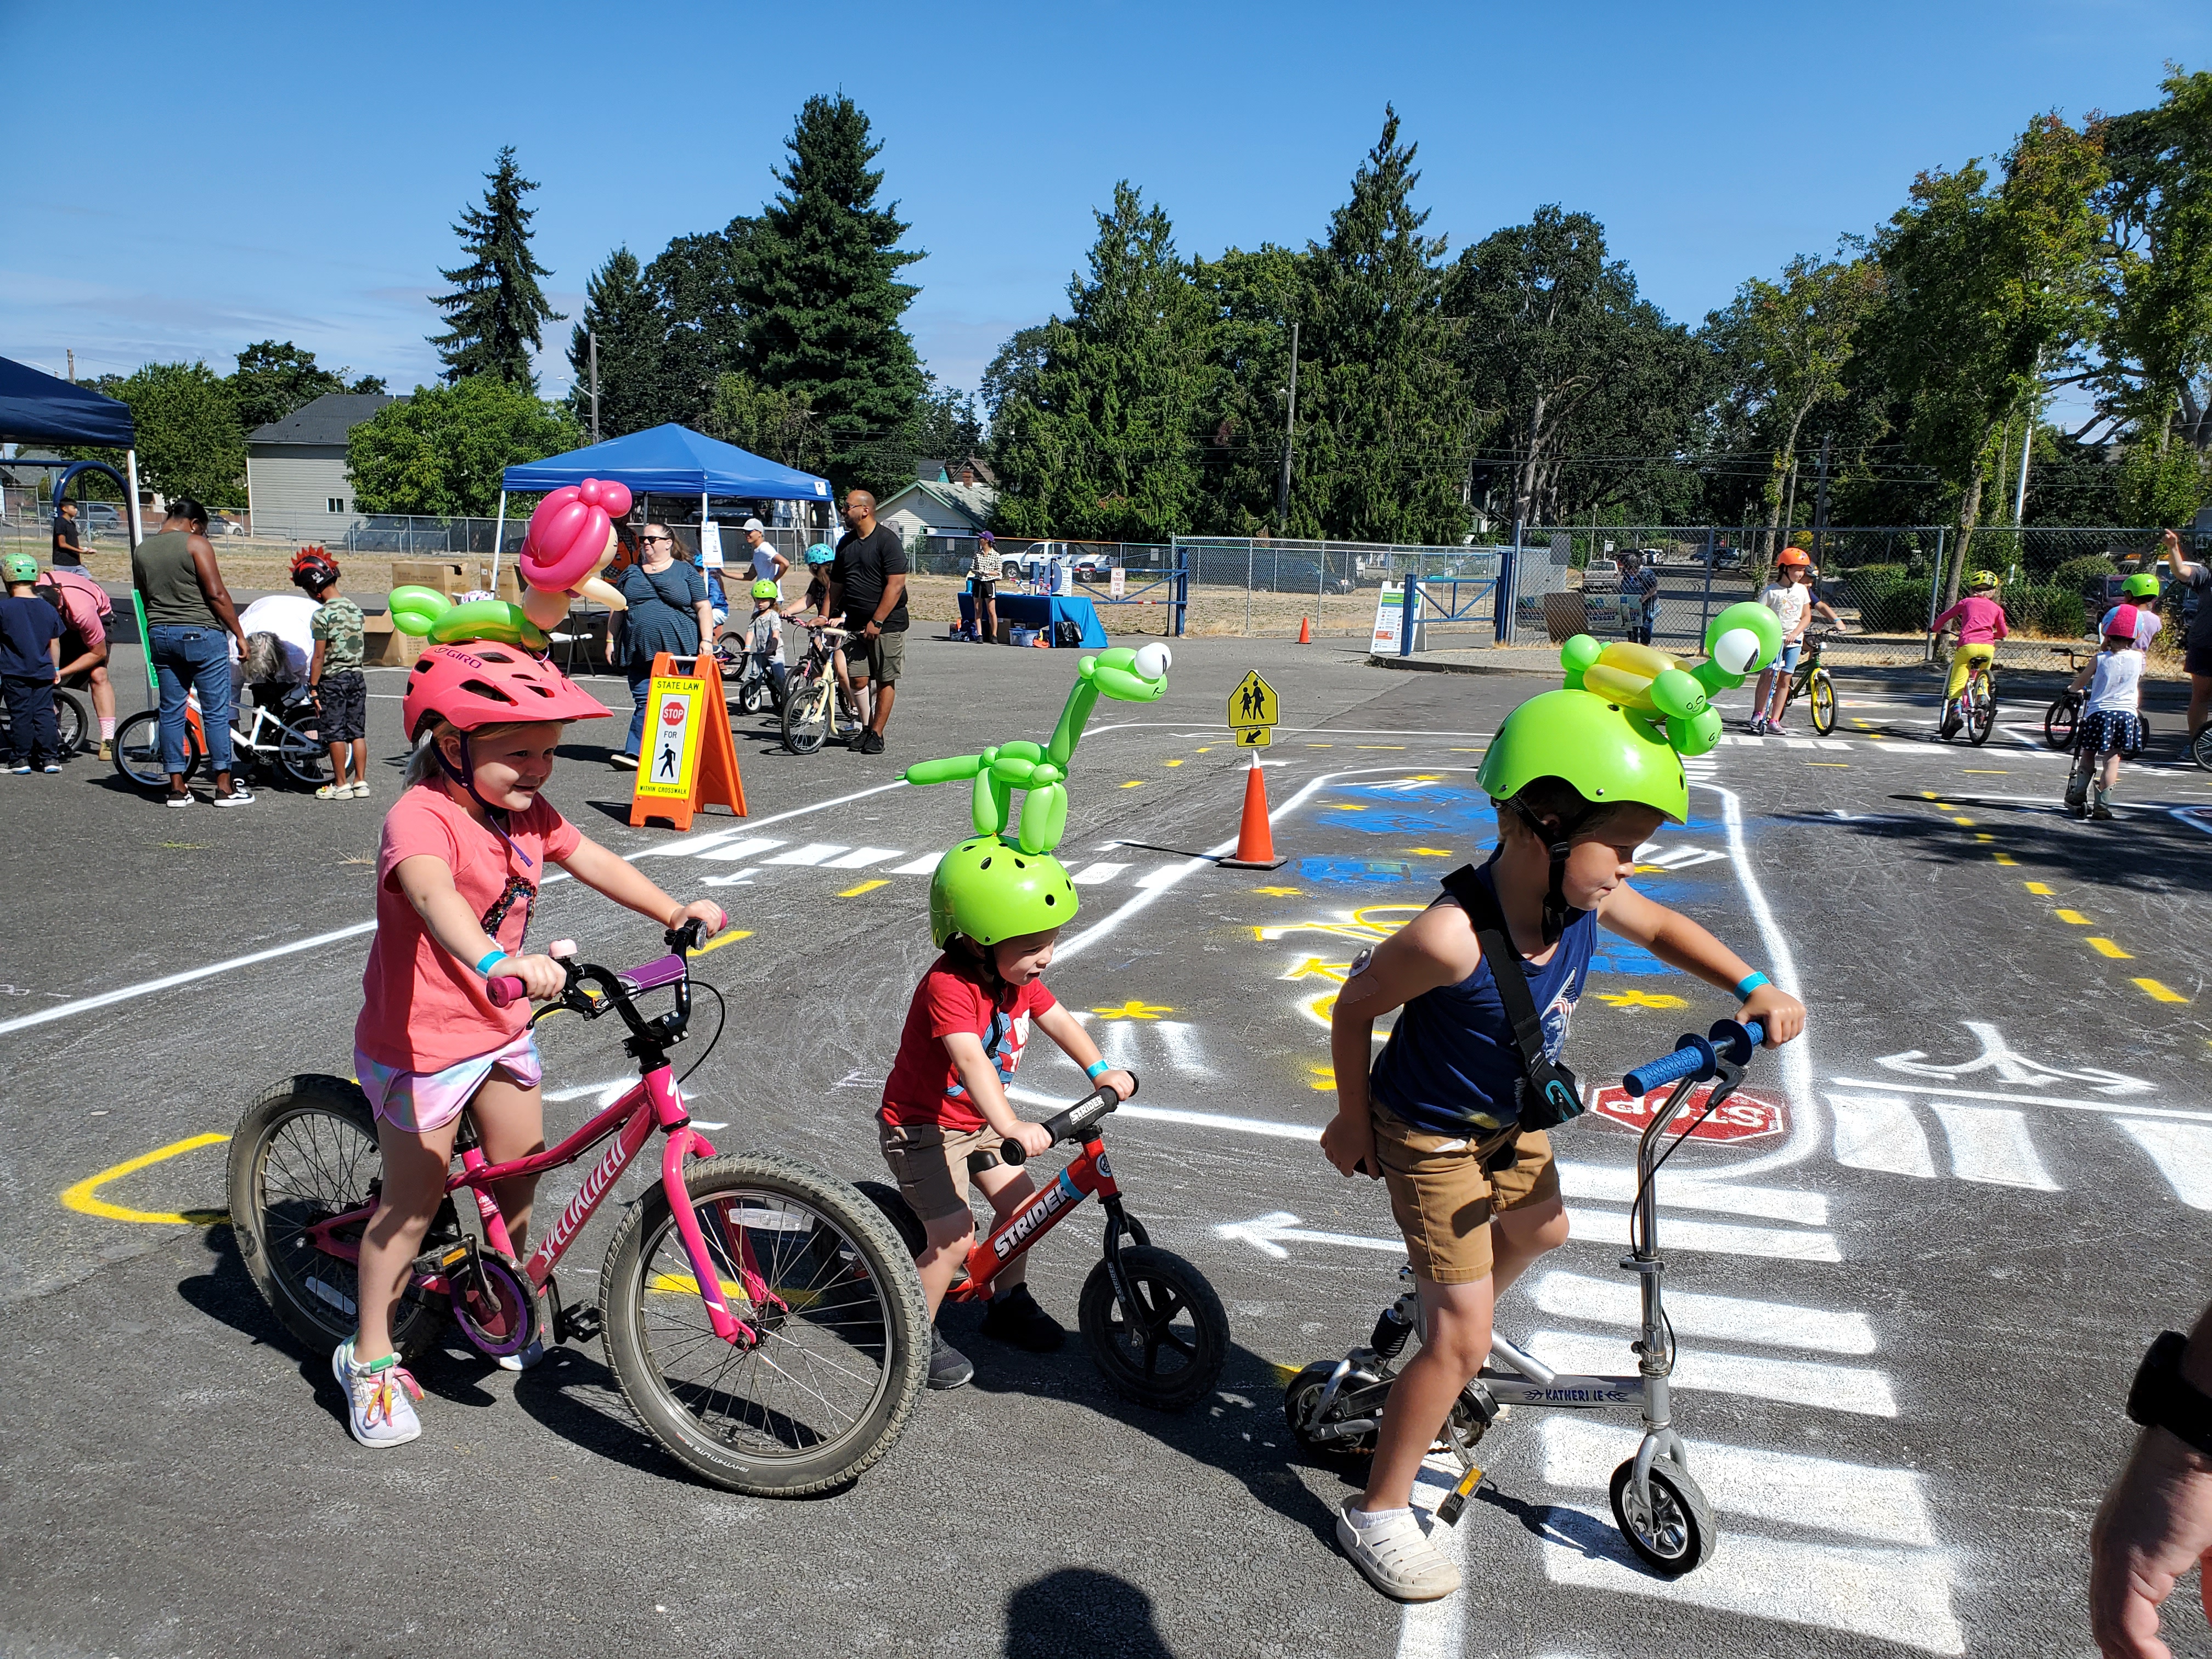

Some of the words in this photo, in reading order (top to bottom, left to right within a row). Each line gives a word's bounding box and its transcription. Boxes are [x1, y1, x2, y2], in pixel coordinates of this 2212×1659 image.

[446, 650, 482, 669] GIRO
[657, 681, 681, 690] STATE
[683, 682, 699, 691] LAW
[663, 709, 684, 719] STOP
[658, 787, 687, 795] CROSSWALK
[1069, 1095, 1105, 1125] STRIDER
[1605, 1097, 1767, 1128] STOP
[538, 1135, 626, 1268] SPECIALIZED
[994, 1182, 1072, 1261] STRIDER
[1107, 1262, 1124, 1295] STRIDER
[692, 1446, 712, 1459] LITE
[710, 1455, 749, 1472] RHYTHM
